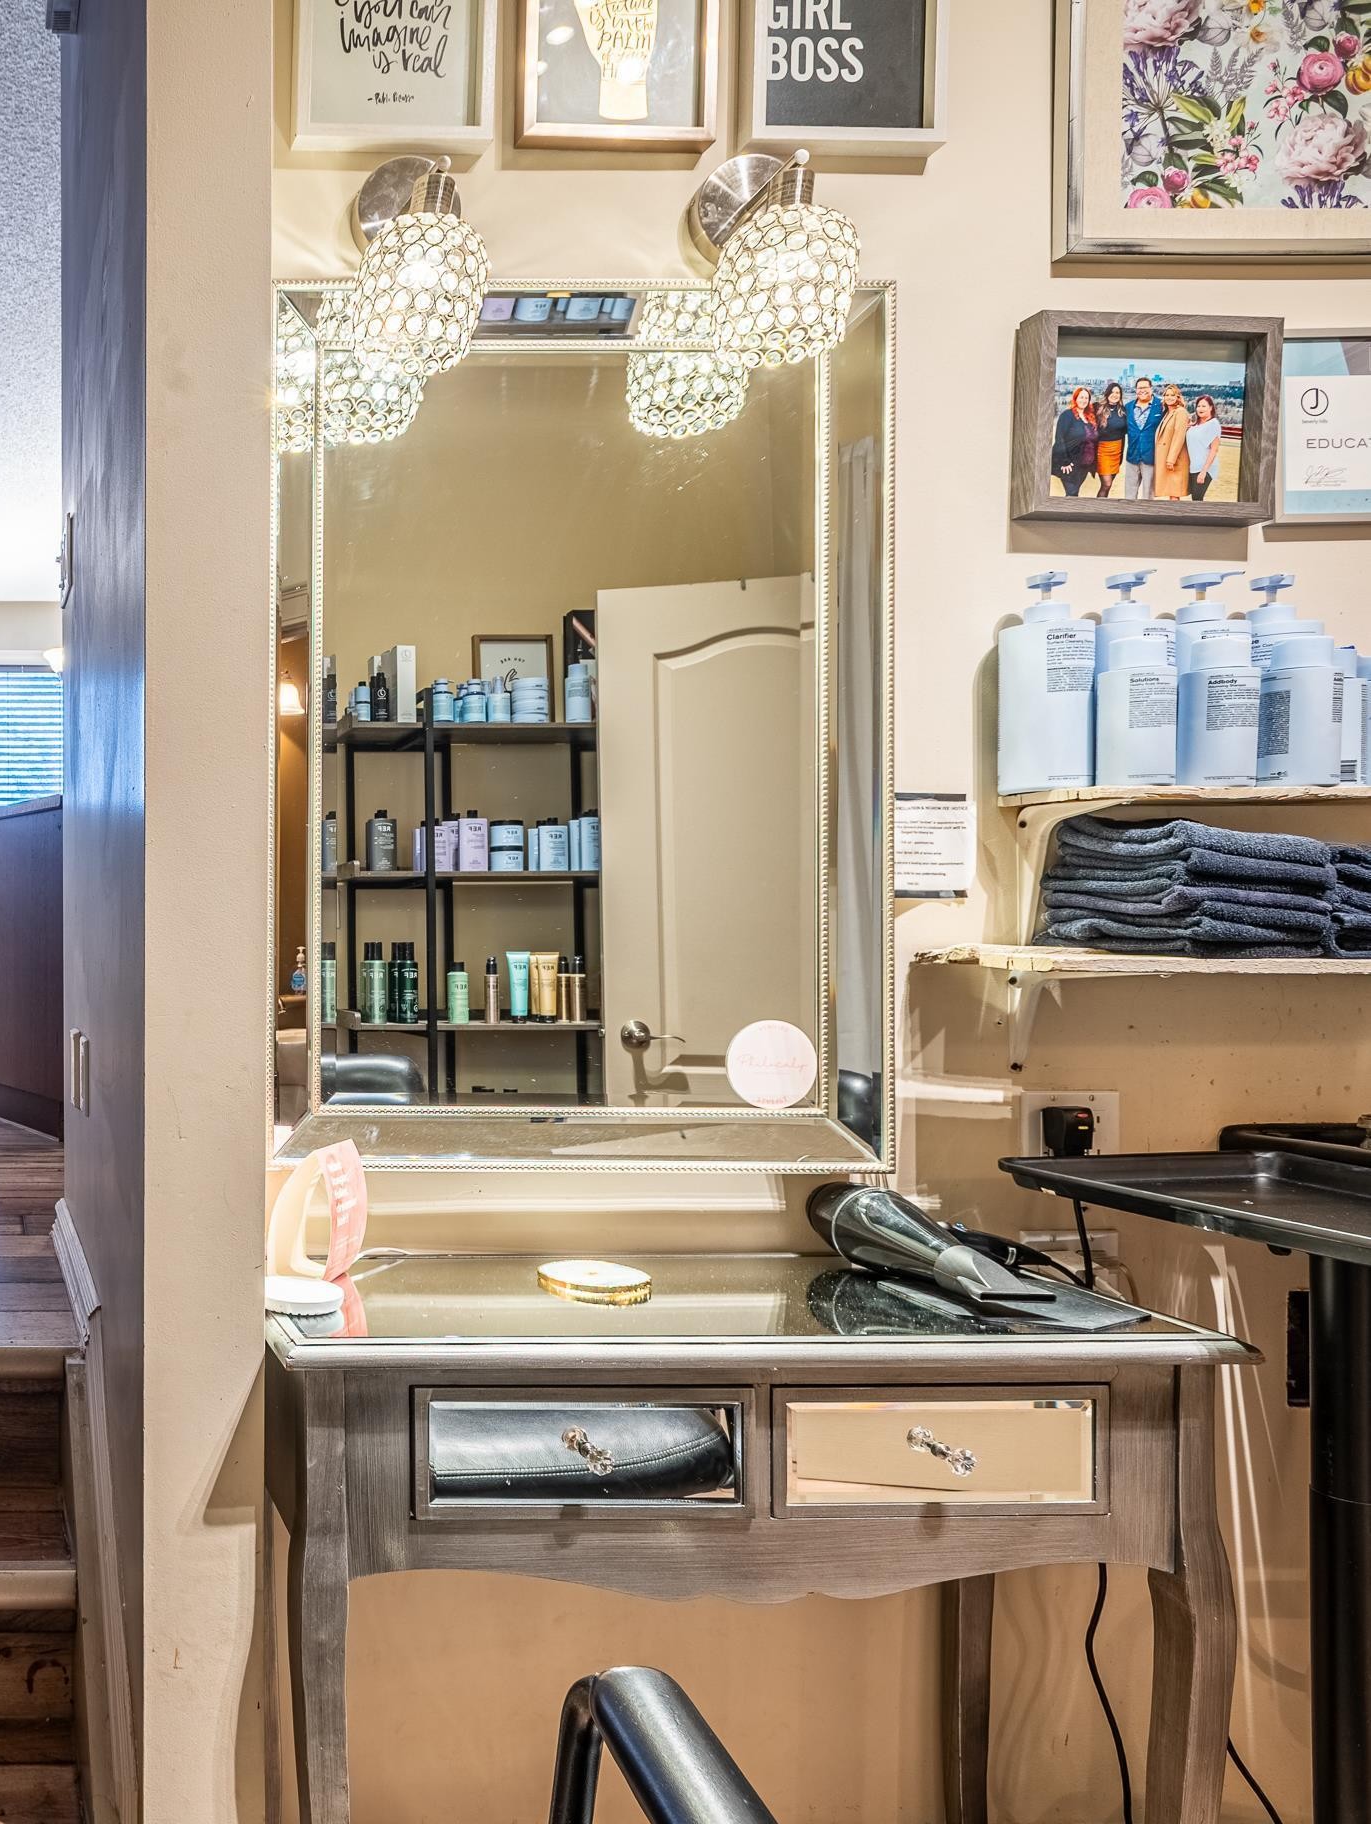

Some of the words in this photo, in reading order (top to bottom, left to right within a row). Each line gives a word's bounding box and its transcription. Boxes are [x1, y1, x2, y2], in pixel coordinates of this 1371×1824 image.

[353, 0, 402, 29] you
[768, 0, 852, 30] GIRL
[340, 11, 432, 54] imagine
[597, 29, 651, 51] PALM
[372, 49, 398, 74] is
[401, 34, 448, 78] real
[767, 36, 864, 83] BOSS
[1306, 437, 1371, 449] EDUCA
